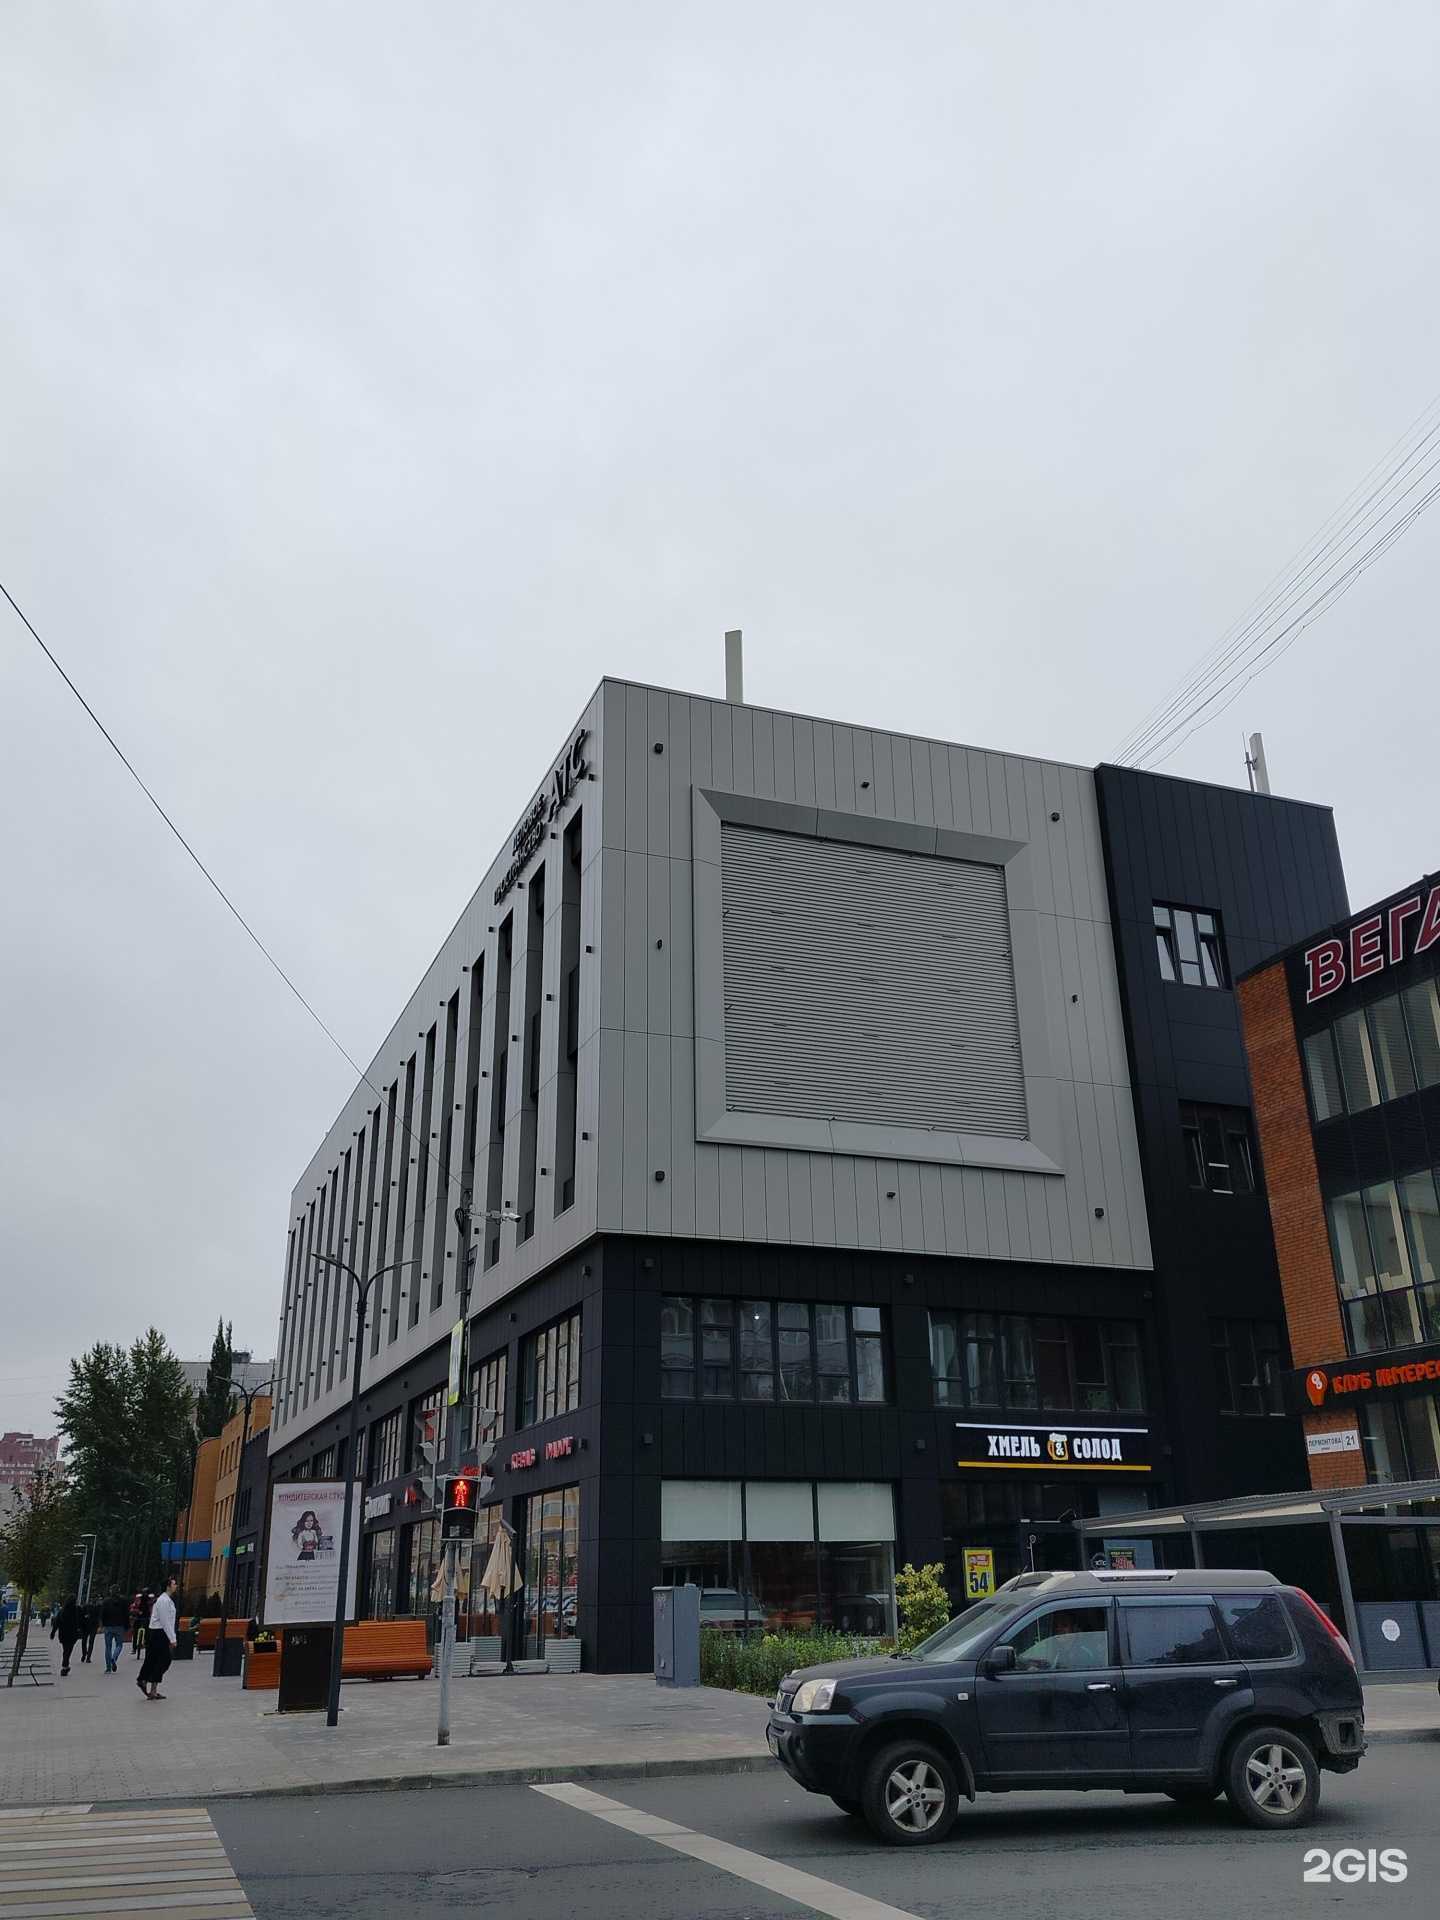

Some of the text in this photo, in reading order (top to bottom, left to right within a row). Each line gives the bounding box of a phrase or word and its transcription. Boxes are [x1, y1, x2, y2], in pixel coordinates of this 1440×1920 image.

[1333, 1371, 1372, 1393] КЛУБ
[987, 1435, 1041, 1458] ХМЕЛЬ
[1073, 1438, 1123, 1462] СОЛОД
[1345, 1435, 1356, 1446] 21
[969, 1572, 989, 1593] 54
